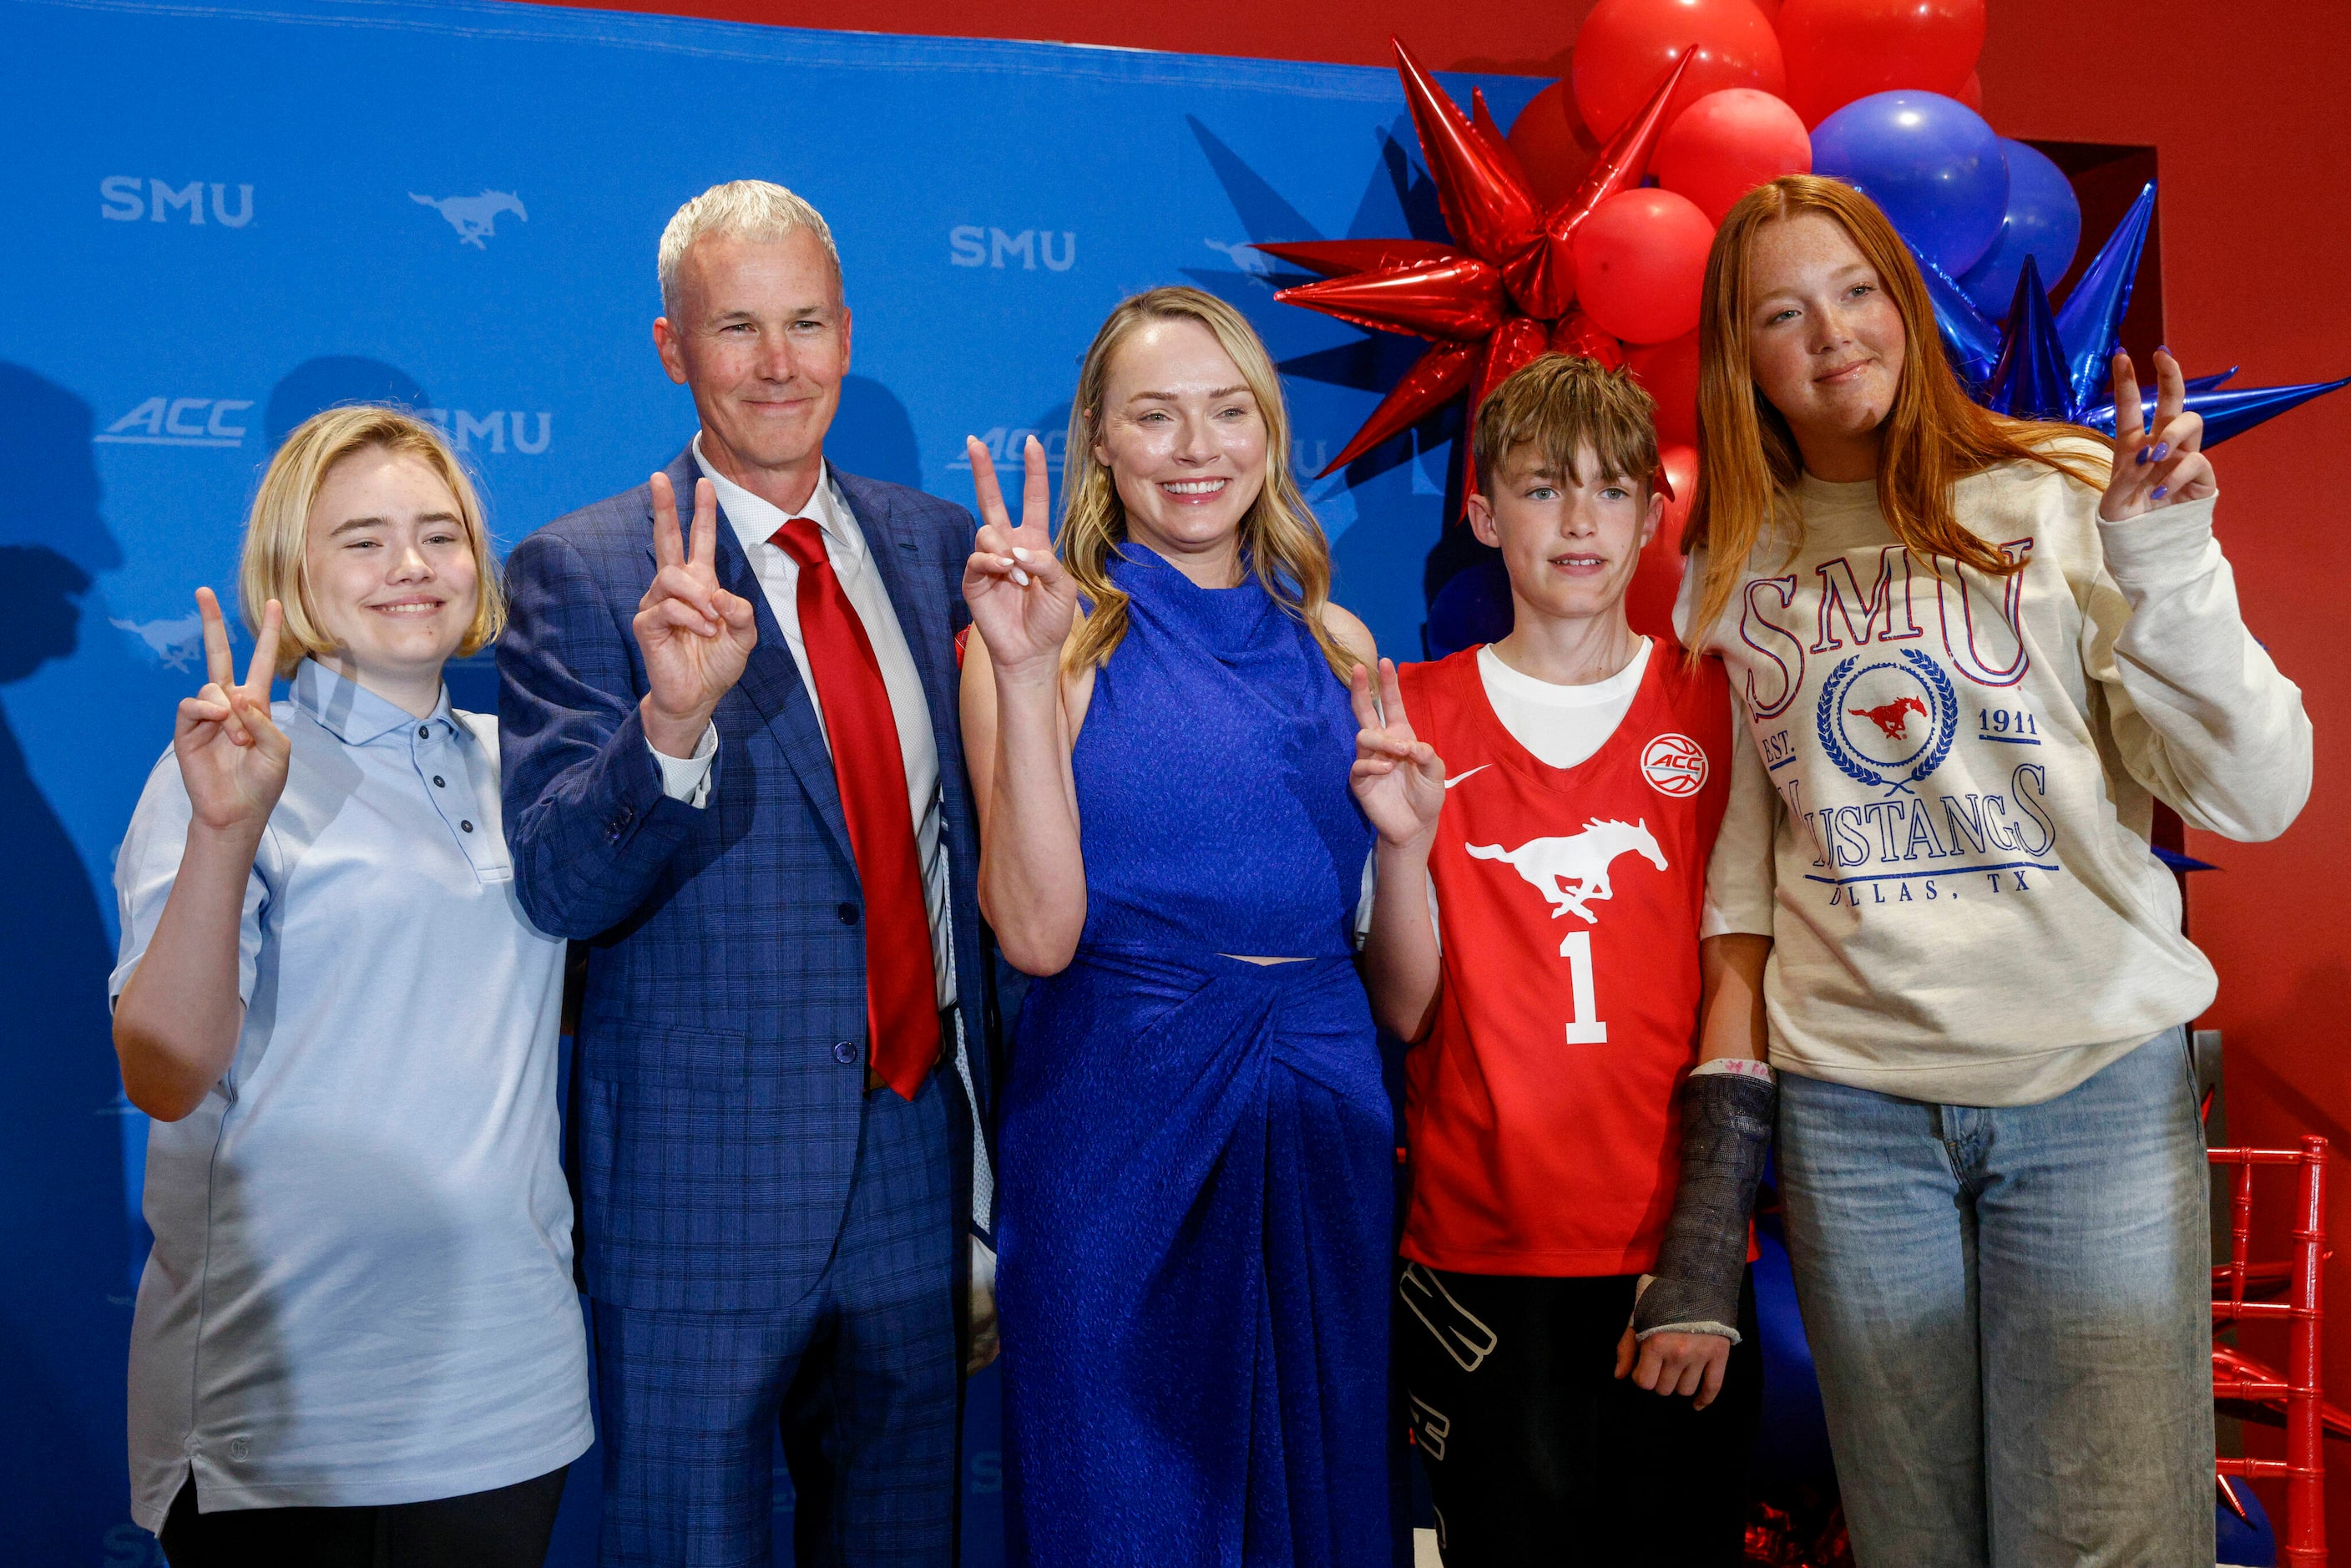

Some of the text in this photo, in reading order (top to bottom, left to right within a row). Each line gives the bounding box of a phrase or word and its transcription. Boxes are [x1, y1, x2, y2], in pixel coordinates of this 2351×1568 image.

[100, 175, 254, 228] SMU
[949, 225, 1076, 271] SMU
[102, 397, 255, 438] ACC
[957, 427, 1068, 462] ACC
[1740, 537, 2034, 724] SMU
[1979, 709, 2037, 735] 1911
[1651, 754, 1703, 771] ACC
[1762, 730, 1795, 762] EST.
[1829, 871, 2030, 908] DLLAS, TX
[1560, 931, 1608, 1044] 1
